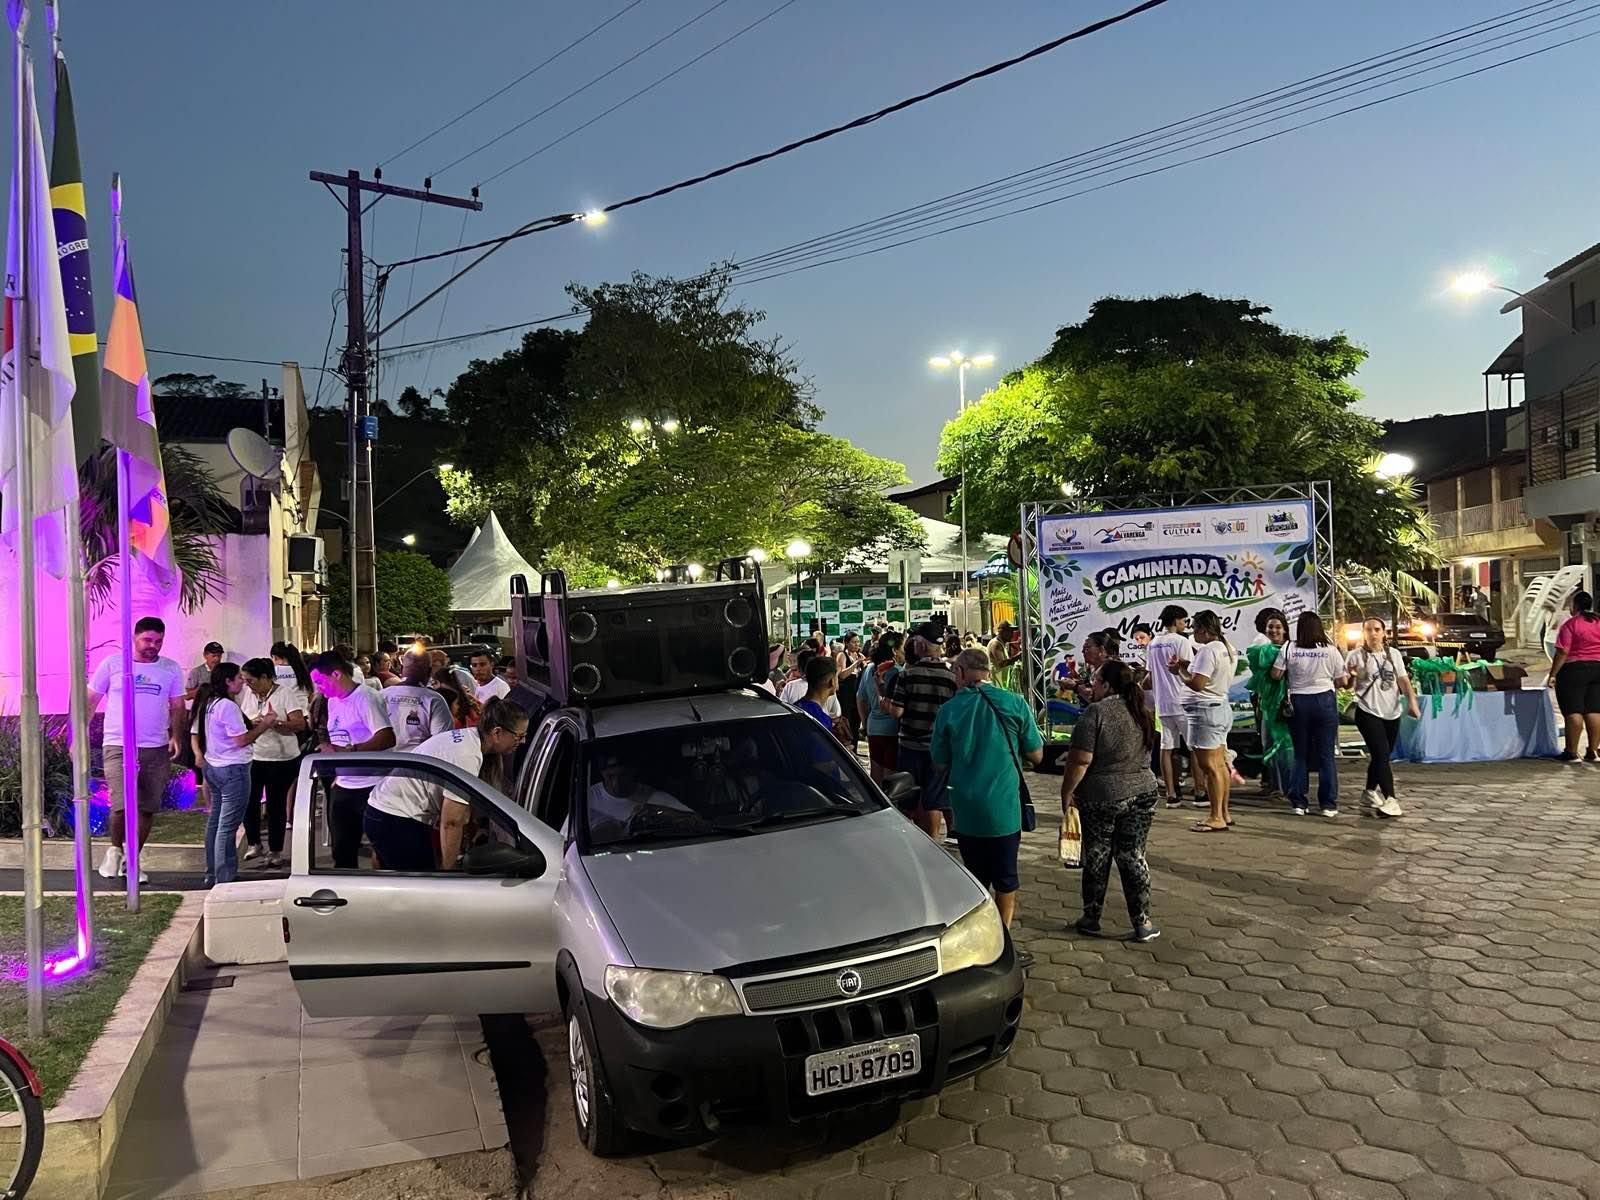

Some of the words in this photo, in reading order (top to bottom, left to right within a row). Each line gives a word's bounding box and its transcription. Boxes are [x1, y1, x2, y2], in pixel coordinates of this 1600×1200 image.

[1162, 527, 1202, 536] CULTURA
[1102, 559, 1223, 588] CAMINHADA
[1105, 579, 1224, 609] ORIENTADA
[842, 977, 858, 988] FIAT
